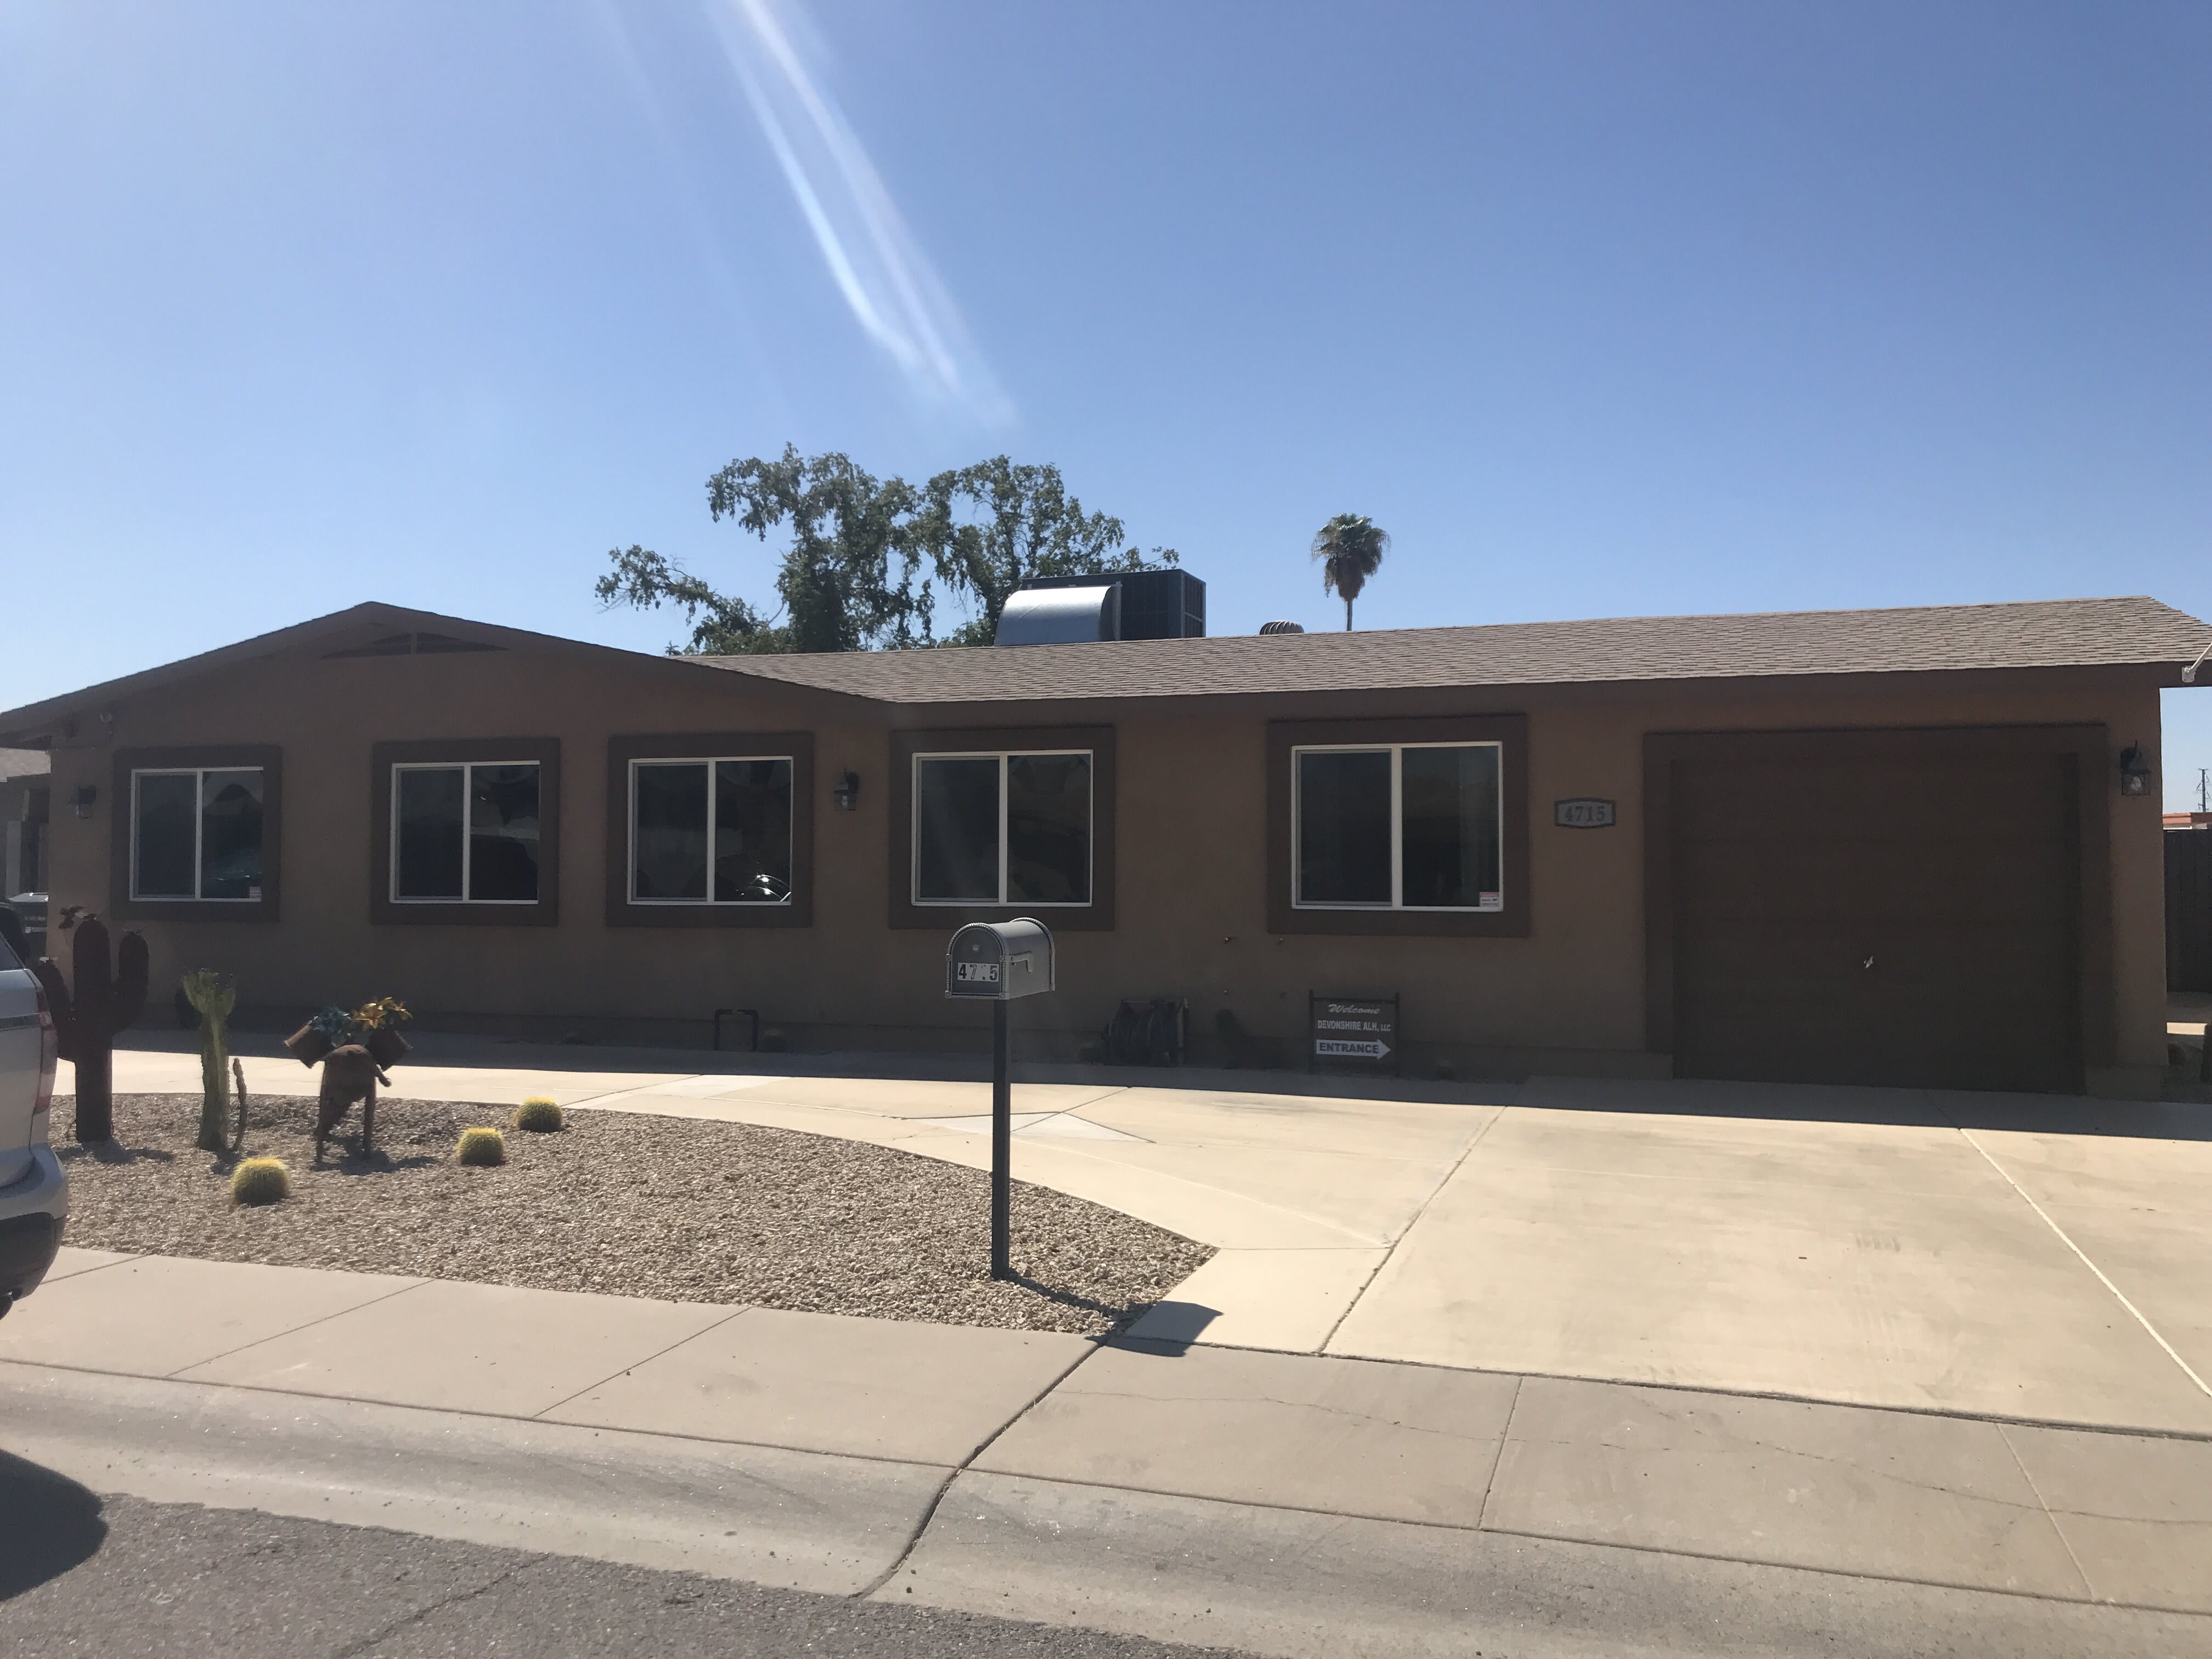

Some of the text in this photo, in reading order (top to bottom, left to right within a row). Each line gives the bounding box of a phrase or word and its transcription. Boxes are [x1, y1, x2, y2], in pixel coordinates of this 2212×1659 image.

[1565, 805, 1605, 822] 4715
[958, 964, 997, 980] 475
[1328, 1004, 1380, 1014] Welcome
[1318, 1020, 1361, 1030] DEVONSHIRE
[1319, 1043, 1379, 1053] ENTRANCE
